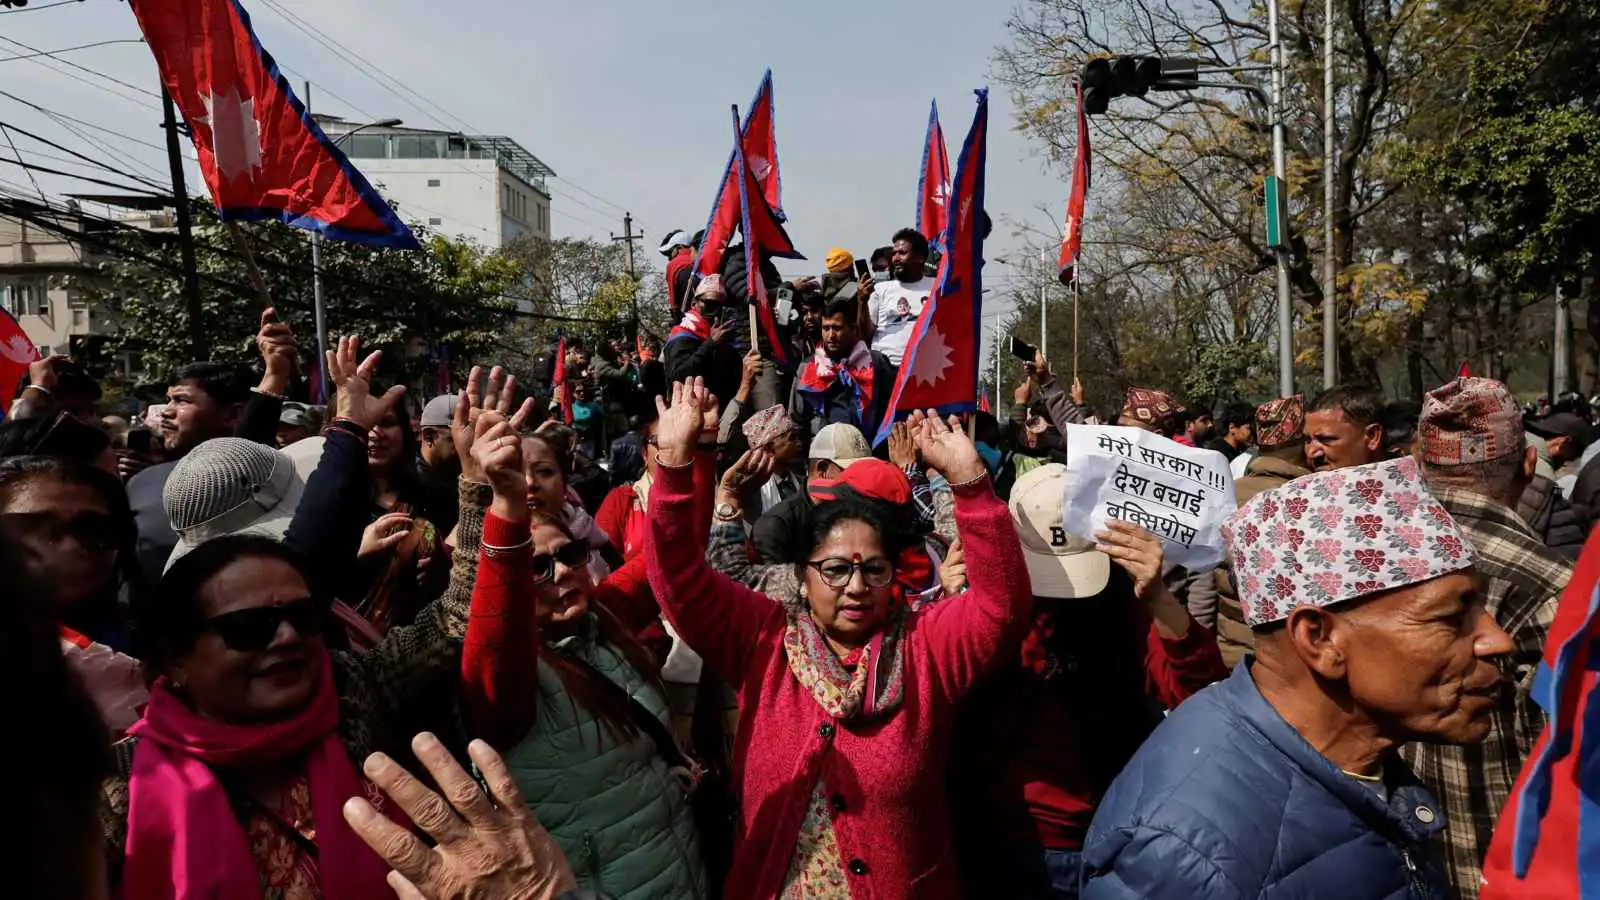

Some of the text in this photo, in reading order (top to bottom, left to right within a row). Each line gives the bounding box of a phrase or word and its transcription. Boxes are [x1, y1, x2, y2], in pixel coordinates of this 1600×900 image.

[1097, 434, 1225, 490] मेरो सरकार !!!
[1114, 463, 1205, 517] देश बचाई
[1049, 526, 1067, 546] B
